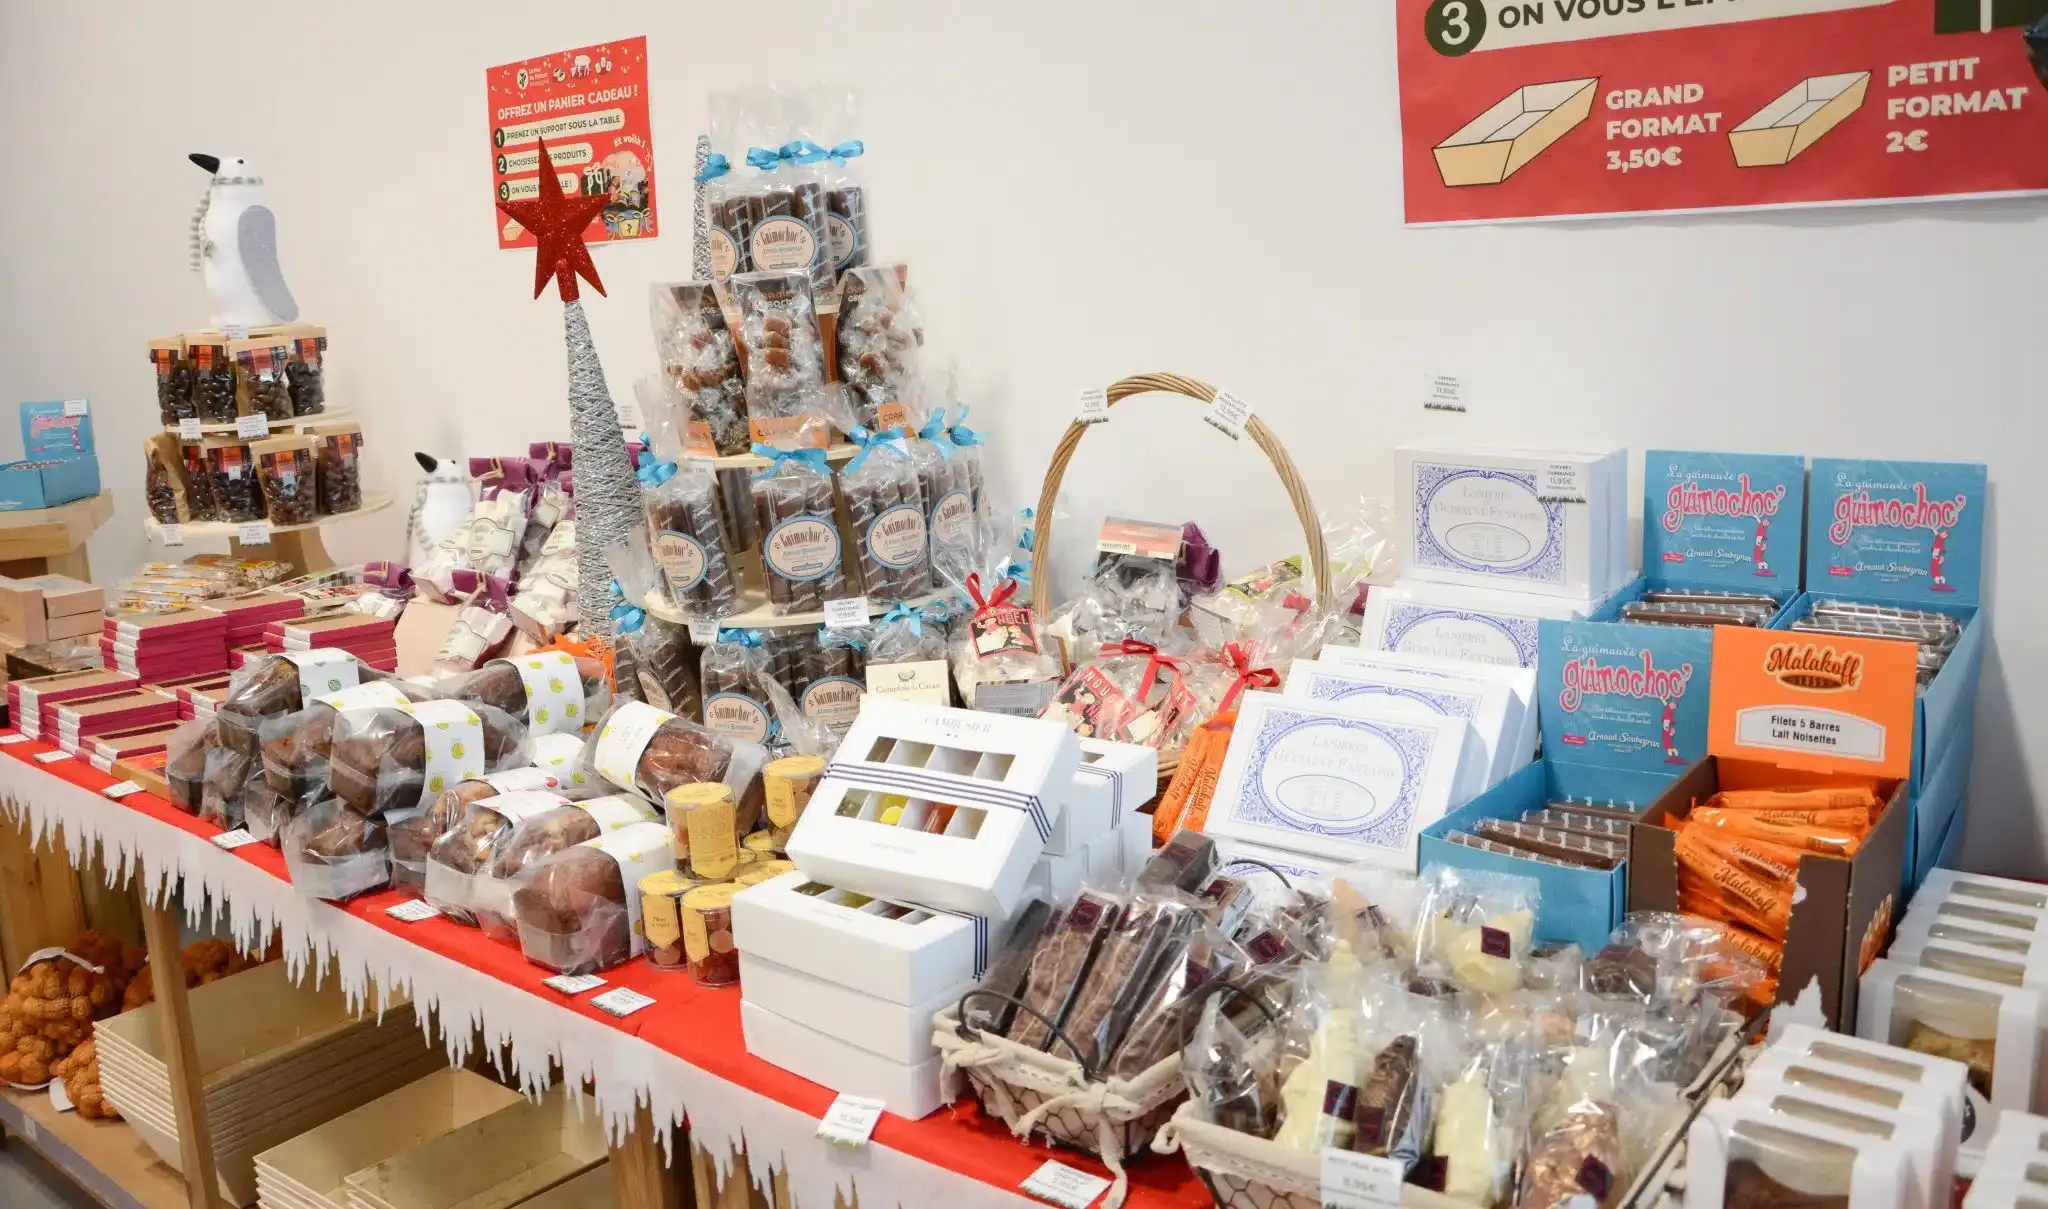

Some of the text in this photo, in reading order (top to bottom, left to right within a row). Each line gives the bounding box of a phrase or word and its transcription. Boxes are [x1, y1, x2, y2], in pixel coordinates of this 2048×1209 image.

[1441, 1, 1470, 45] 3
[1499, 3, 1543, 28] ON
[1888, 57, 1979, 87] PETIT
[498, 102, 533, 120] OFFREZ
[534, 101, 547, 113] UN
[548, 94, 585, 111] PANIER
[588, 86, 633, 104] CADEAU
[1606, 83, 1704, 111] GRAND
[1888, 87, 2028, 120] FORMAT
[506, 129, 529, 140] PRENEZ
[530, 127, 539, 137] UN
[540, 123, 567, 135] SUPPORT
[568, 120, 587, 131] SOUS
[589, 118, 598, 127] LA
[600, 114, 620, 126] TABLE
[1606, 112, 1722, 140] FORMAT
[553, 149, 587, 160] PRODUITS
[613, 138, 622, 147] Et
[1886, 129, 1929, 154] 2€
[1606, 146, 1683, 174] 3,50€
[511, 185, 519, 194] ON
[520, 183, 537, 194] VOUS
[1666, 463, 1736, 483] La guimauve
[1833, 472, 1910, 493] La guimauve
[1561, 636, 1637, 659] La guimauve
[1766, 645, 1861, 688] Malakoff
[1771, 715, 1840, 732] Filets 5 Barres
[1772, 728, 1837, 746] Lait Noisettes
[1714, 867, 1778, 915] Malakoff
